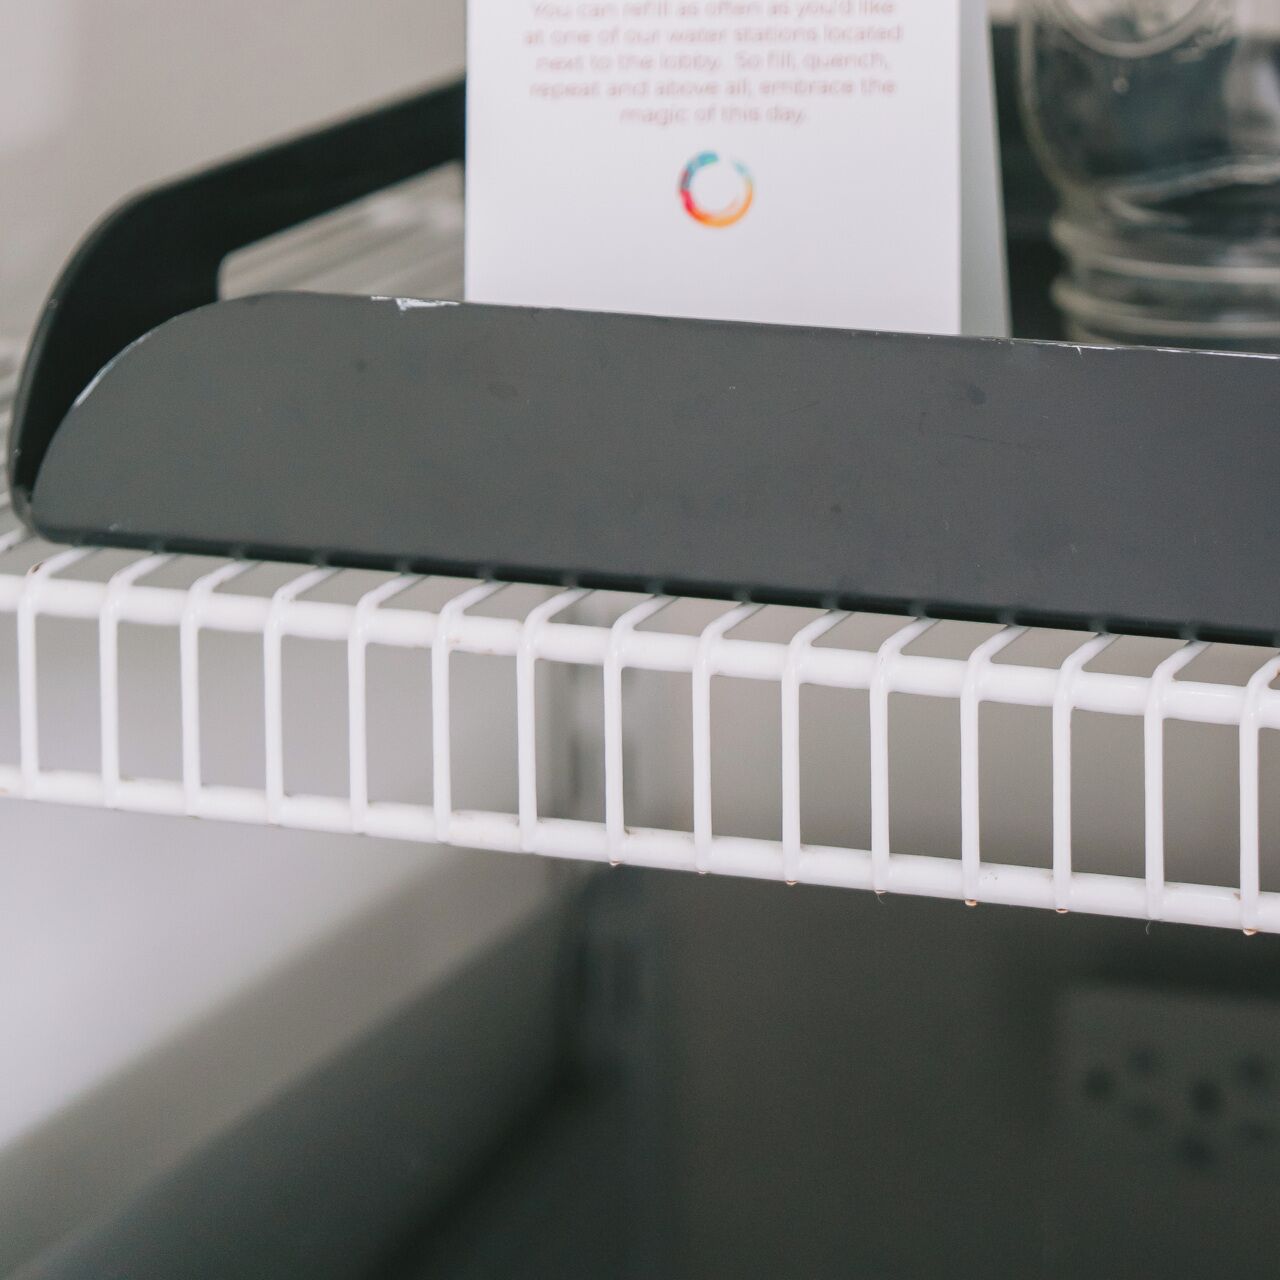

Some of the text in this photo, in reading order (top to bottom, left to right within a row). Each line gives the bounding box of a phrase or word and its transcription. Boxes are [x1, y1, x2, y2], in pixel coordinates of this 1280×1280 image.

[533, 2, 572, 18] You
[577, 4, 616, 18] can
[704, 0, 762, 17] often
[551, 31, 592, 45] one
[669, 28, 728, 44] water
[617, 53, 654, 71] the
[530, 82, 600, 101] repeat
[607, 80, 650, 97] and
[758, 77, 855, 96] embrace
[861, 77, 897, 95] the
[619, 106, 688, 128] magic
[720, 104, 761, 124] this
